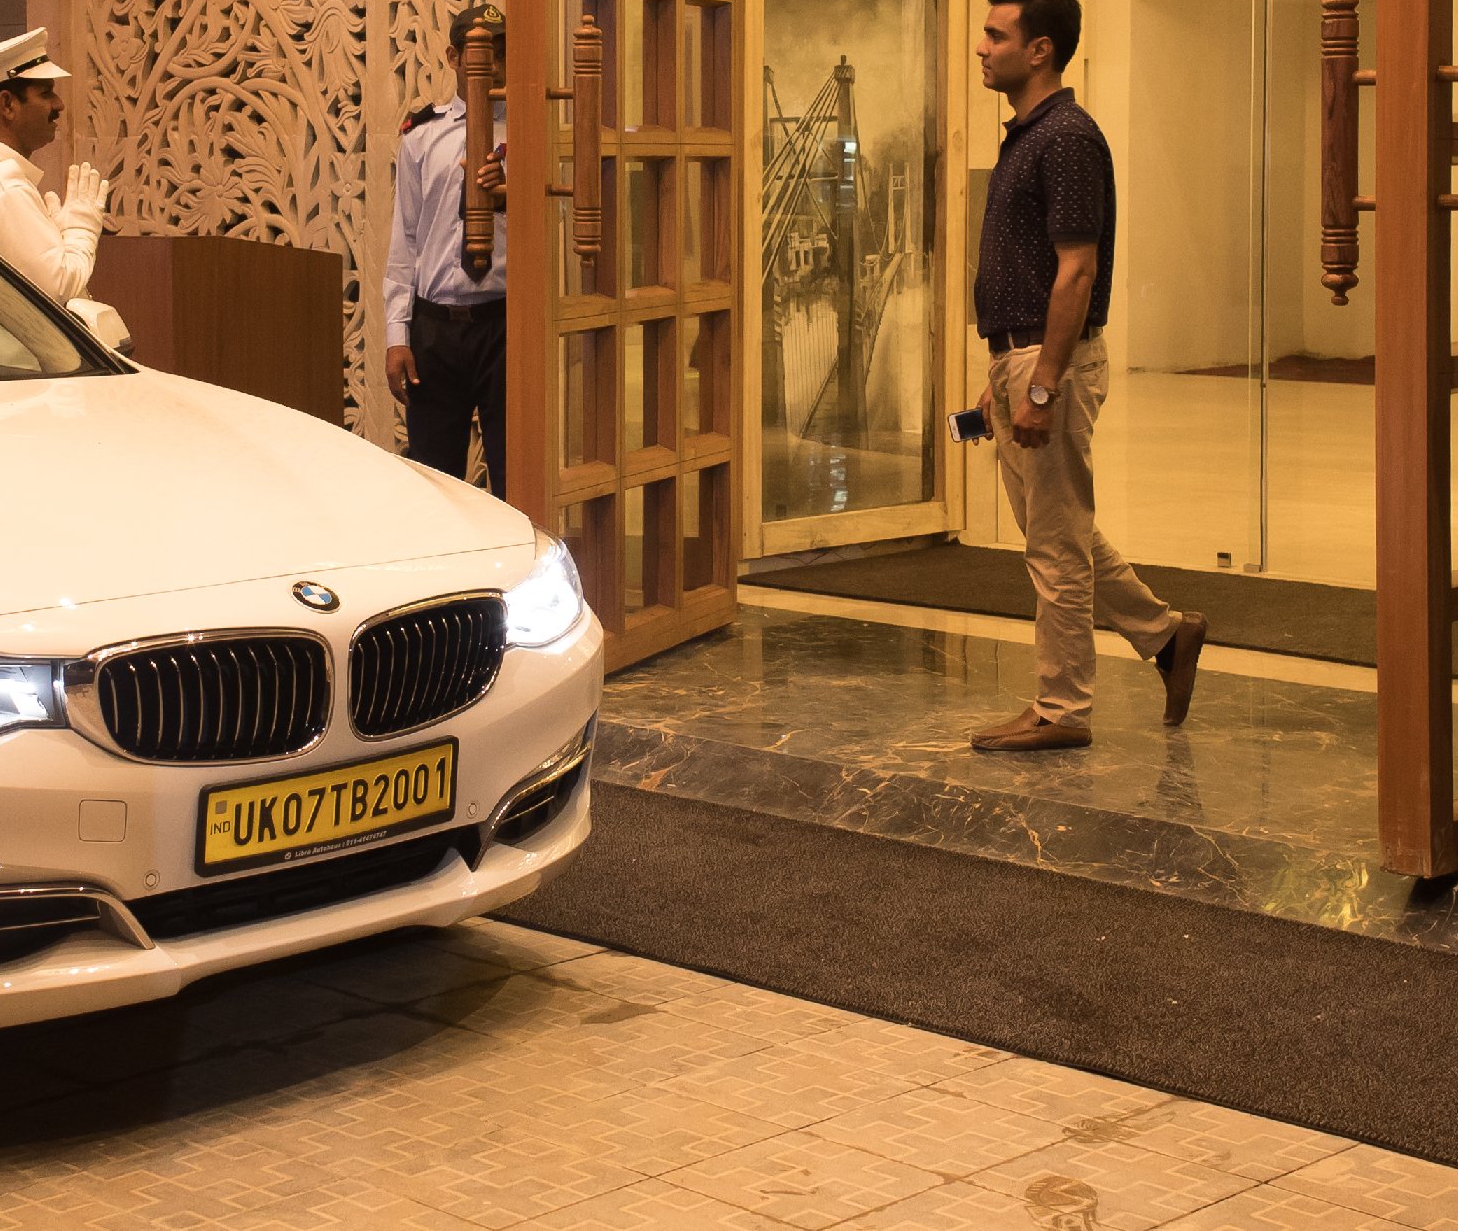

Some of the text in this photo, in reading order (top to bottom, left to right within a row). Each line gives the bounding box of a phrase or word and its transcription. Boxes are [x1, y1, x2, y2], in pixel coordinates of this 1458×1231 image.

[234, 756, 446, 845] UK07TB2001
[210, 820, 231, 836] IND
[295, 849, 311, 858] Libra
